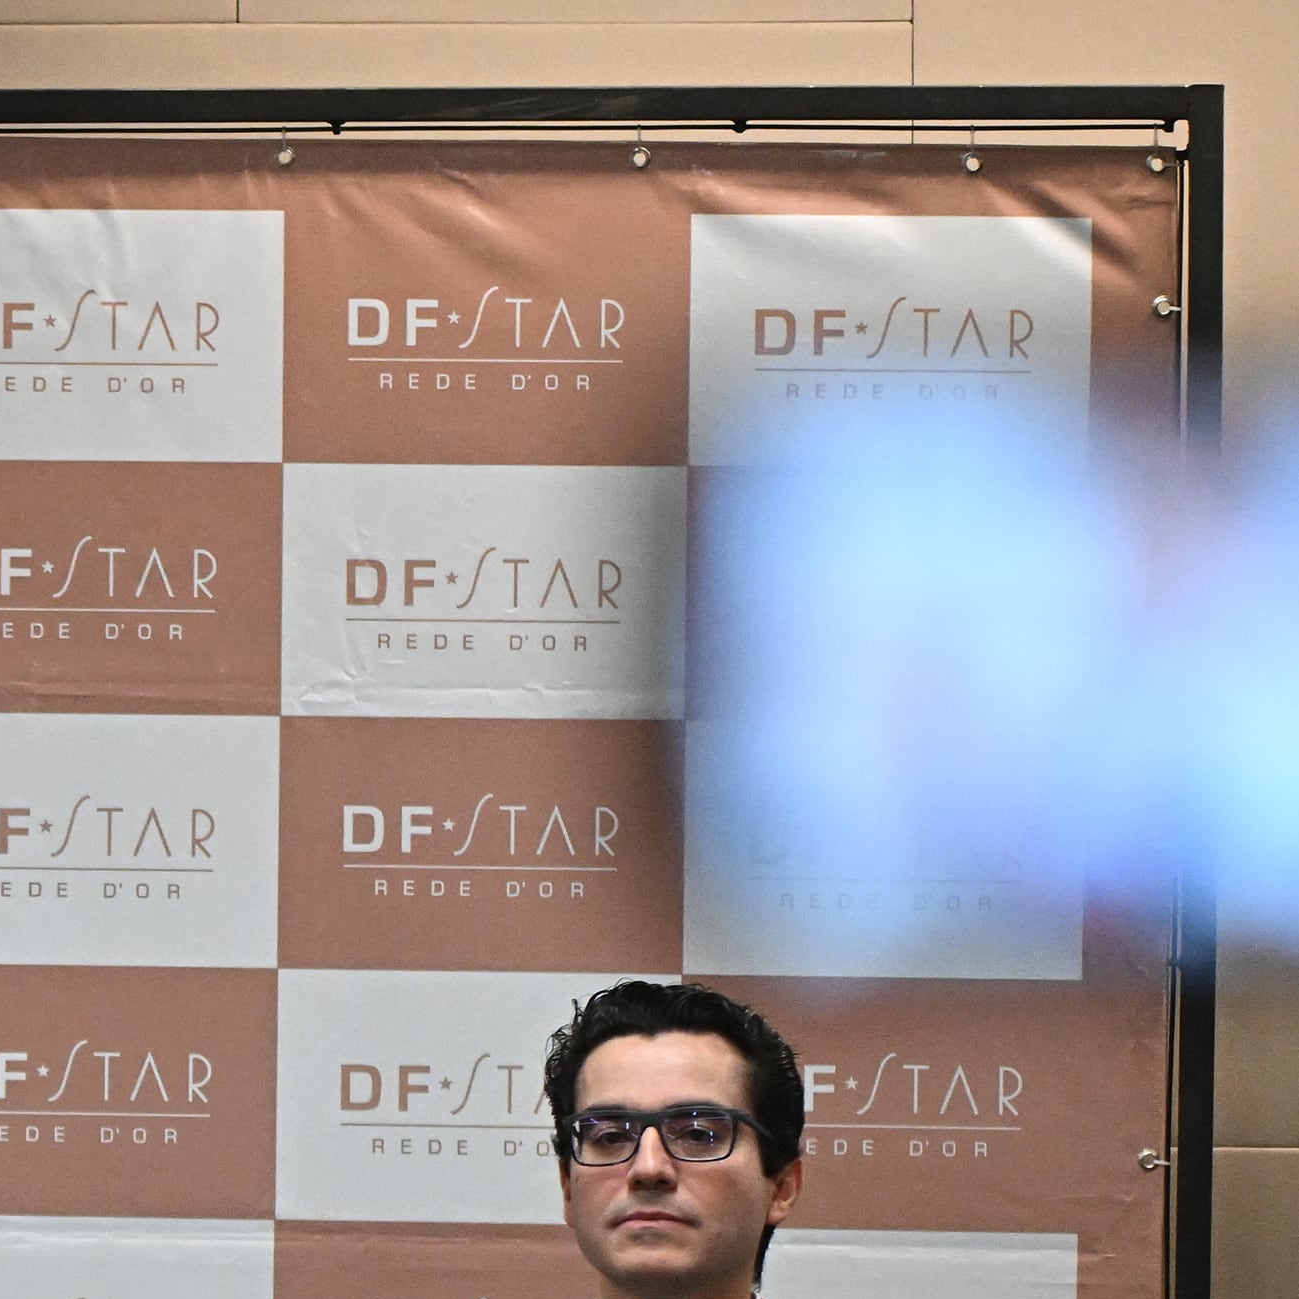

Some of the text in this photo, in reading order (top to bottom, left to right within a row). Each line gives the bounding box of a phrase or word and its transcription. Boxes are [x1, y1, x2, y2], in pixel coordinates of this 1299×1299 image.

[55, 289, 219, 352] STAR
[348, 286, 624, 348] DF STAR
[755, 297, 1034, 359] DF STAR
[108, 377, 185, 394] D'OR
[380, 373, 589, 390] REDE D'OR
[53, 536, 217, 598] STAR
[346, 547, 621, 609] DF STAR
[105, 623, 182, 640] D'OR
[378, 634, 587, 651] REDE D'OR
[51, 795, 215, 858] STAR
[343, 794, 619, 856] DF STAR
[103, 882, 180, 899] D'OR
[375, 880, 583, 897] REDE D'OR
[48, 1040, 212, 1103] STAR
[340, 1064, 431, 1112] DF
[857, 1052, 1023, 1116] STAR
[100, 1127, 177, 1144] D'OR
[372, 1138, 468, 1156] REDE
[805, 1138, 988, 1157] EDE D'OR
